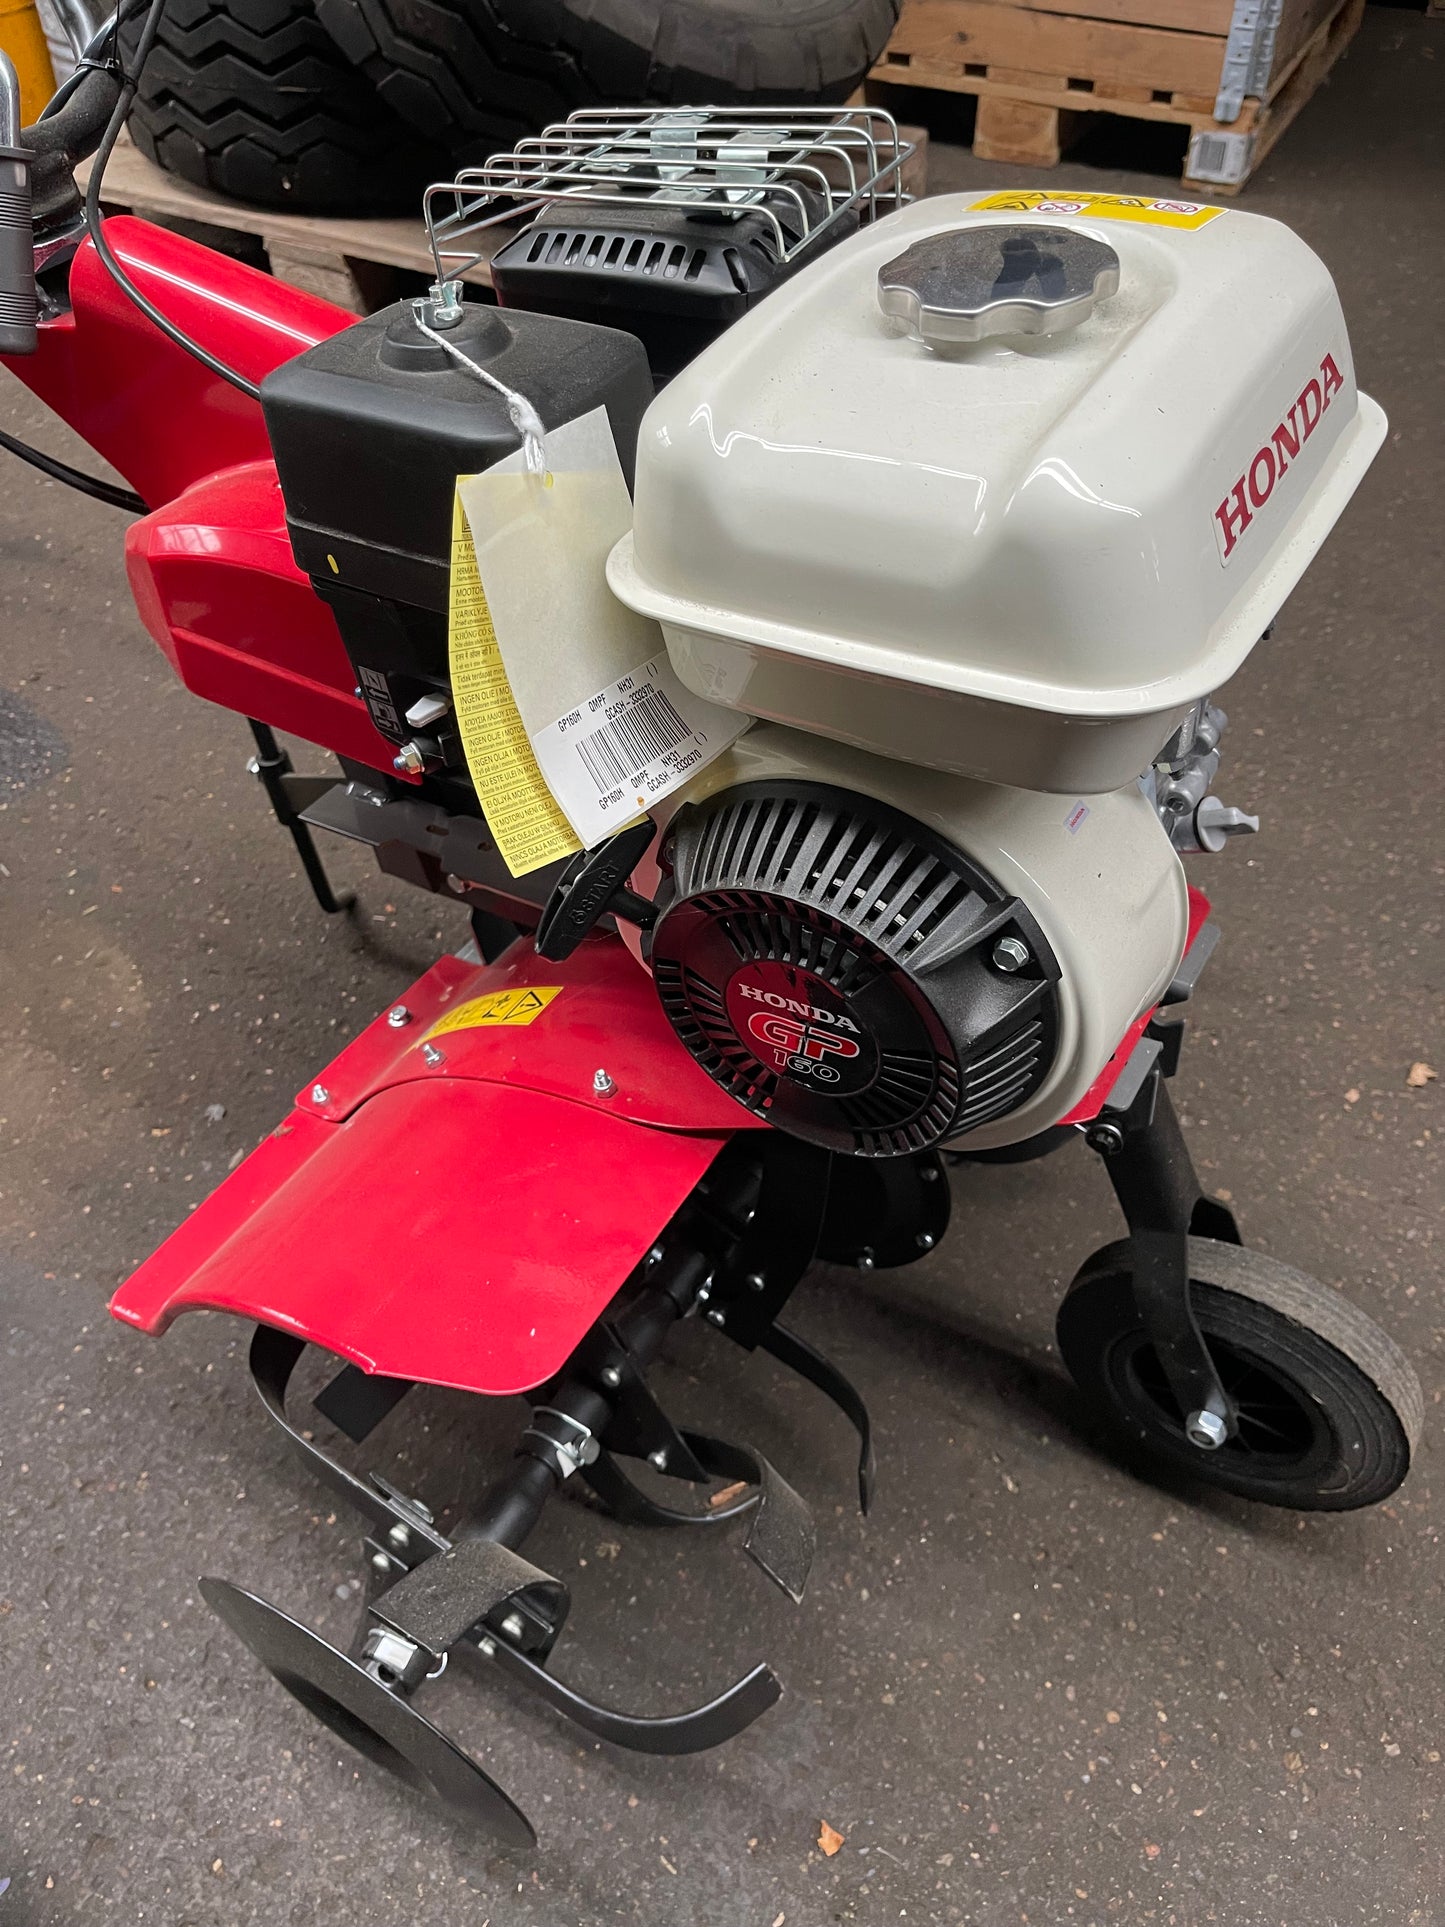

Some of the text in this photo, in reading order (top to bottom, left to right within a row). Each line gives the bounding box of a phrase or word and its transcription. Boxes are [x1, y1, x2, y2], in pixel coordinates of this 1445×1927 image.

[1215, 352, 1344, 560] HONDA
[460, 692, 481, 705] INGEN
[558, 709, 582, 732] GP160H
[588, 693, 607, 712] QMPF
[616, 677, 635, 694] NH31
[469, 734, 488, 747] INGEN
[473, 755, 493, 768] INGEN
[493, 750, 510, 762] OLJA
[479, 779, 490, 788] NU
[489, 773, 504, 785] ESTE
[504, 769, 517, 781] ULEI
[598, 787, 625, 810] GP160H
[630, 769, 650, 789] QMPF
[661, 750, 682, 768] NH31
[499, 811, 525, 826] MOTORU
[537, 800, 552, 812] OLEJ
[509, 849, 529, 863] NINCS
[527, 843, 544, 856] OLAJ
[582, 860, 620, 912] START
[738, 983, 861, 1034] HONDA
[748, 1012, 860, 1061] GP
[773, 1048, 840, 1083] 160
